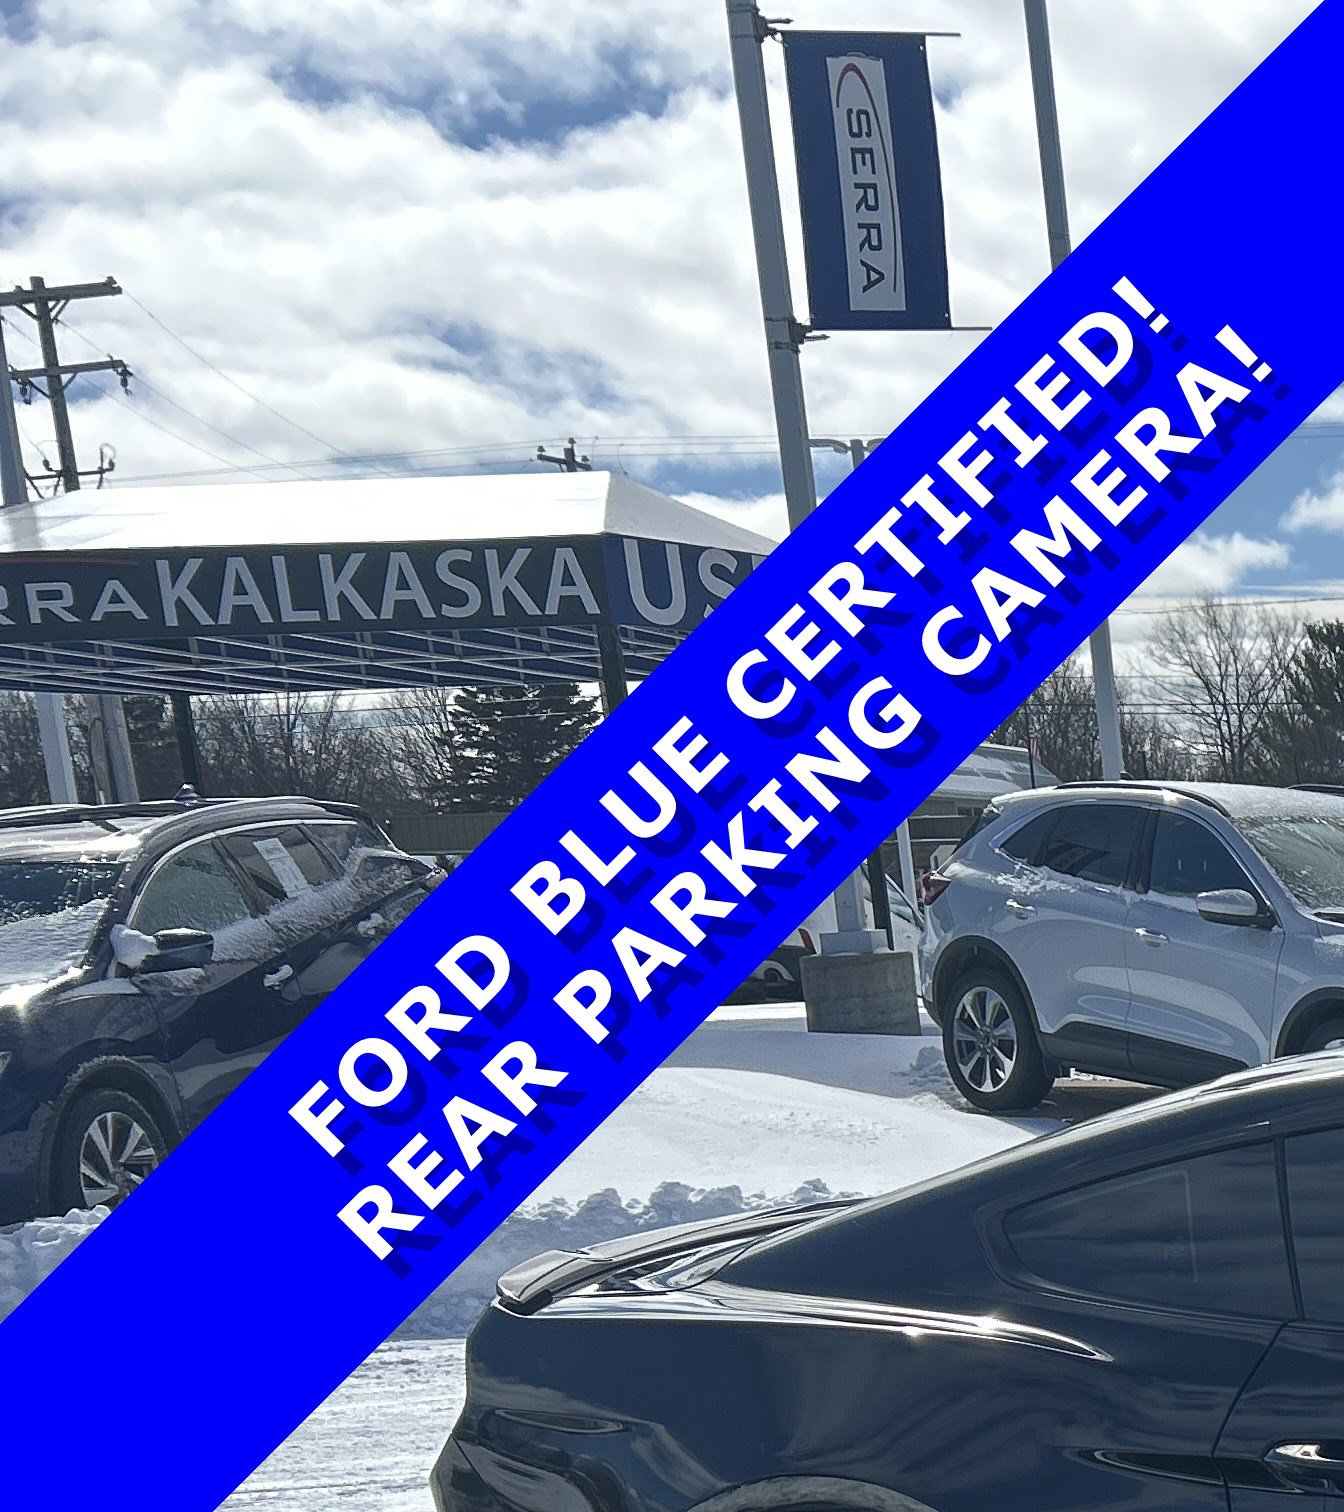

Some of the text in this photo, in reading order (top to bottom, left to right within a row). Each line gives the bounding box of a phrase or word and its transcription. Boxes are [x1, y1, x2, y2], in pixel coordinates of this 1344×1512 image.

[846, 107, 885, 294] SERRA
[0, 538, 770, 627] RA KALKASKA US
